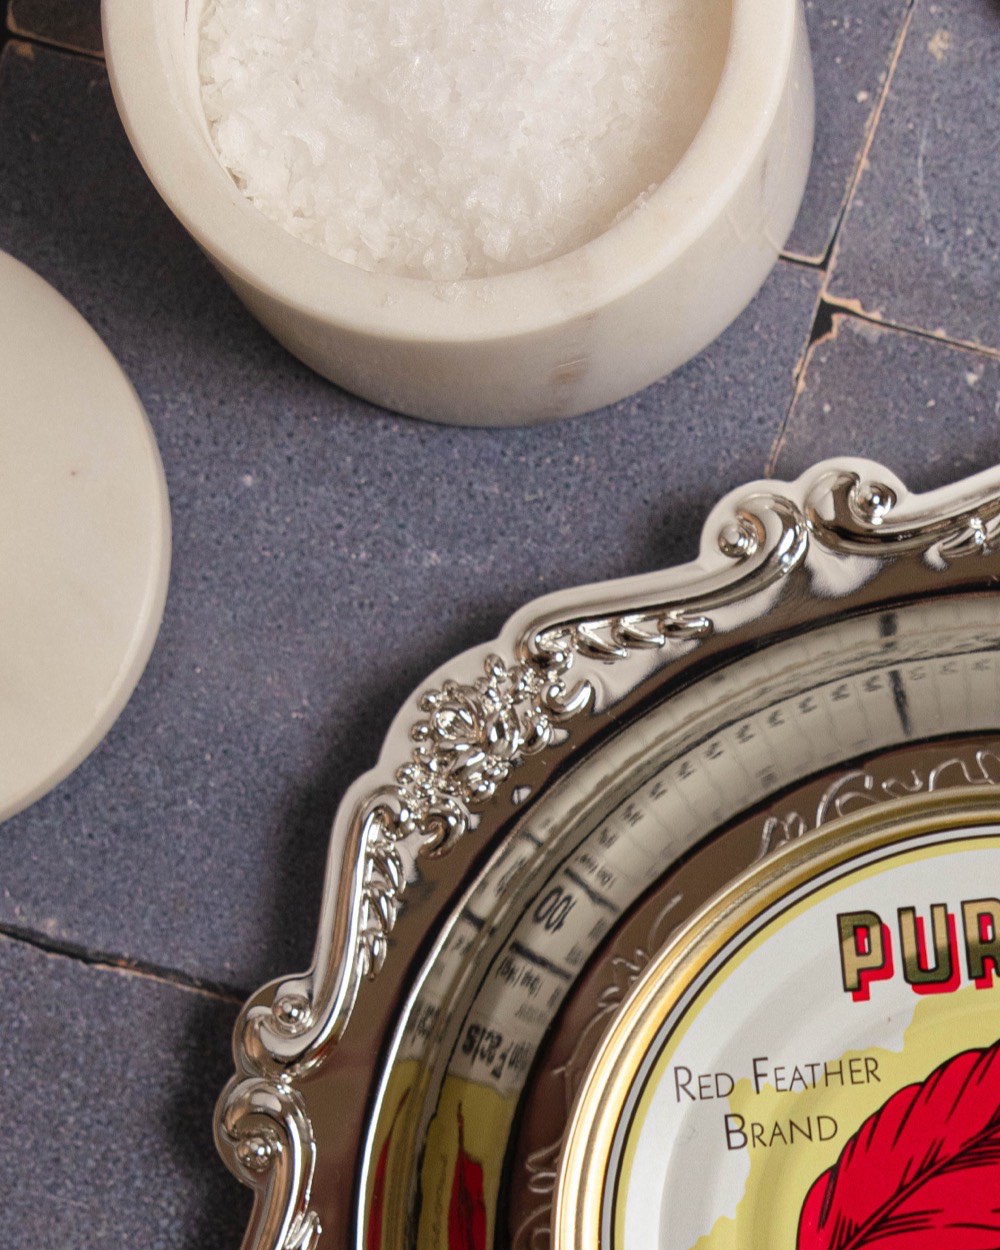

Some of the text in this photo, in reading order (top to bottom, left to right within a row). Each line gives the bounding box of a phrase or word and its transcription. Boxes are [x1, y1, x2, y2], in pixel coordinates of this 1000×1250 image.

[674, 1057, 881, 1102] RED FEATHER
[724, 1113, 838, 1150] BRAND
